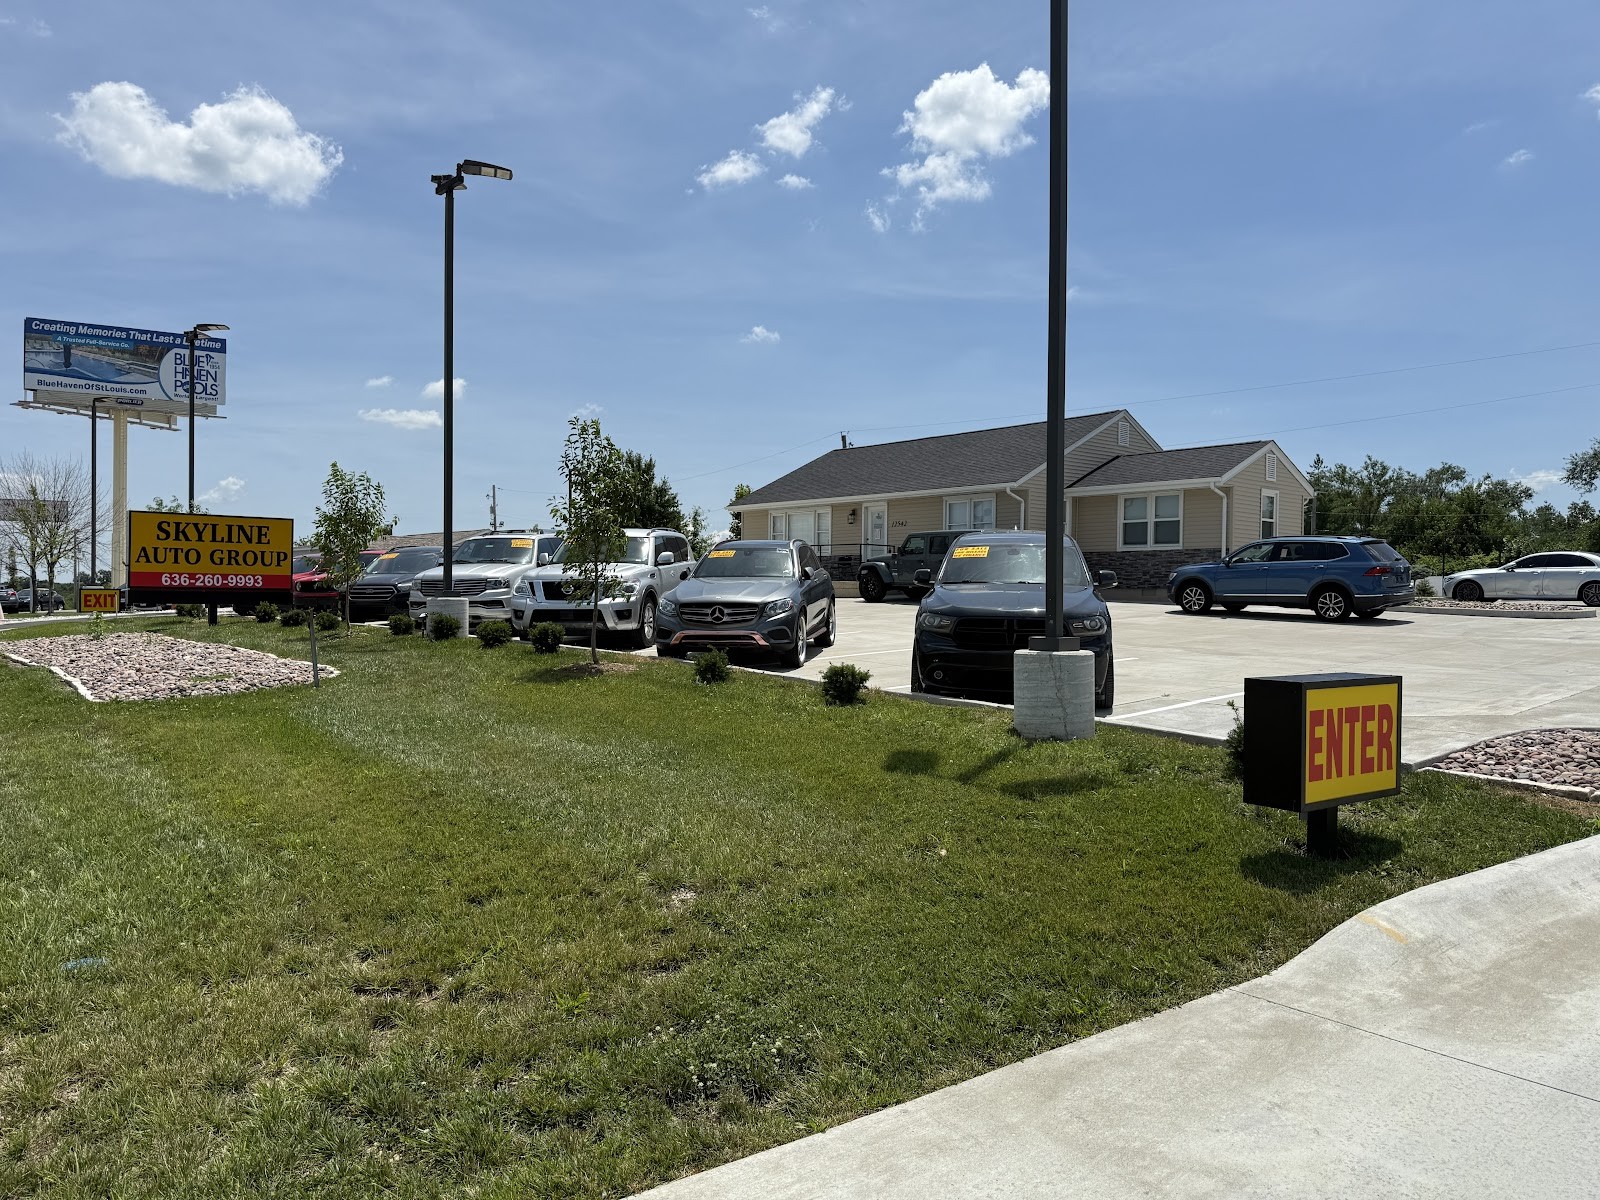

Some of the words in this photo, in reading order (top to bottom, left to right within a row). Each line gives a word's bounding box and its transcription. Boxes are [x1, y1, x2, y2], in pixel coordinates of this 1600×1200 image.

[32, 321, 76, 335] Creating
[78, 325, 127, 339] Memories
[129, 331, 151, 341] That
[153, 333, 174, 344] Last
[182, 336, 221, 349] Letime
[63, 336, 85, 344] Trusted
[86, 339, 119, 347] Full-Service
[37, 379, 147, 395] BlueHavenOfStLouis.com
[156, 520, 271, 545] SKYLINE
[135, 546, 201, 565] AUTO
[209, 549, 288, 568] GROUP
[161, 573, 263, 588] 636-260-9993
[83, 593, 116, 608] EXIT
[1308, 703, 1394, 783] ENTER
